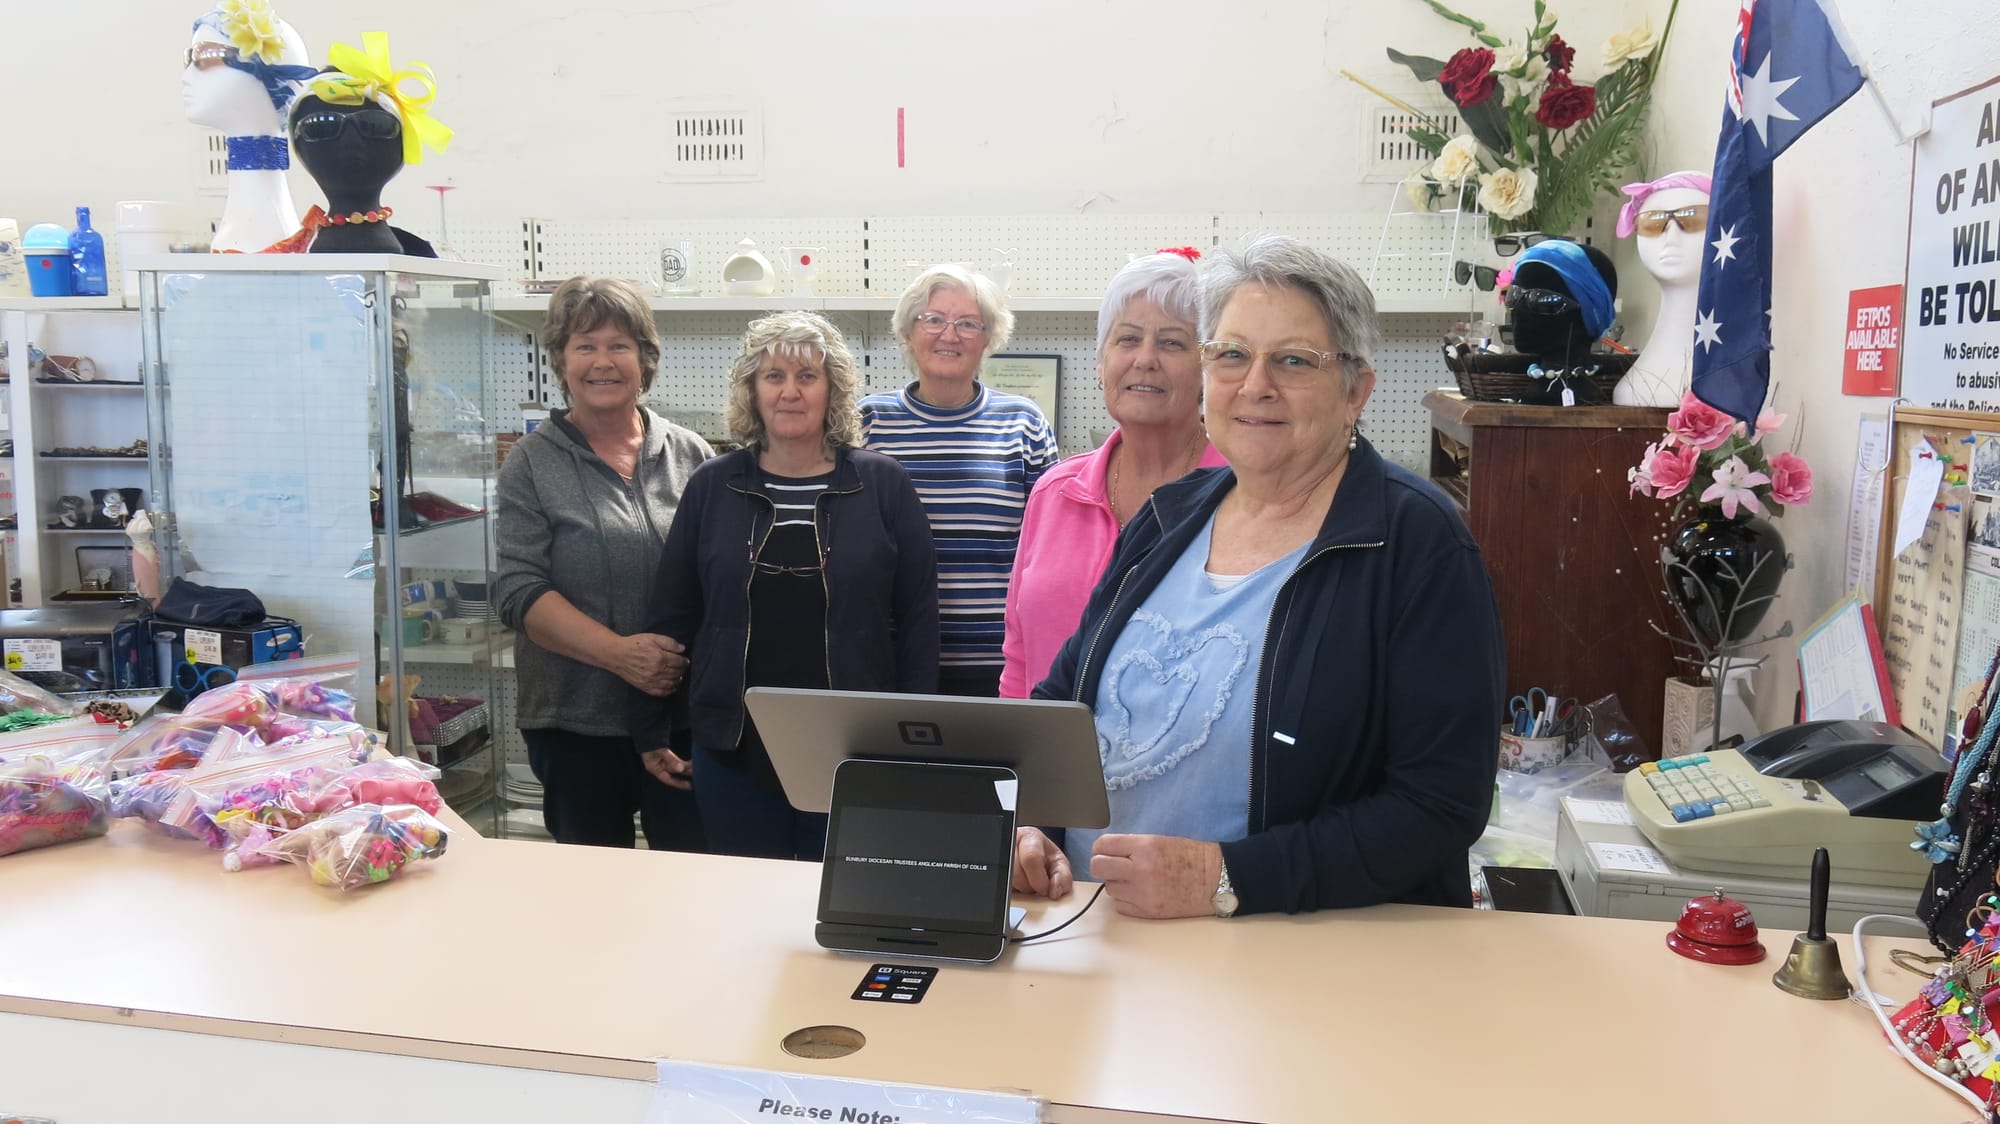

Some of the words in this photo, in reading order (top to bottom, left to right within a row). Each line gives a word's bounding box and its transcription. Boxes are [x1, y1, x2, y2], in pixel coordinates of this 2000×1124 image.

[1976, 99, 2000, 148] A
[1936, 168, 1967, 215] OF
[1953, 219, 2000, 267] WIL
[1919, 285, 1949, 327] BE
[1955, 279, 2000, 324] TOL
[1856, 305, 1891, 328] EFTPOS
[1846, 328, 1898, 350] AVAILABLE
[1856, 351, 1883, 371] HERE.
[1944, 342, 1957, 360] No
[1960, 341, 1999, 360] Service
[1956, 371, 1966, 388] to
[1969, 371, 2000, 389] abusi
[868, 857, 893, 865] DIOCESAN
[894, 968, 927, 976] Square
[758, 1098, 833, 1121] Please
[839, 1106, 901, 1124] Note:
